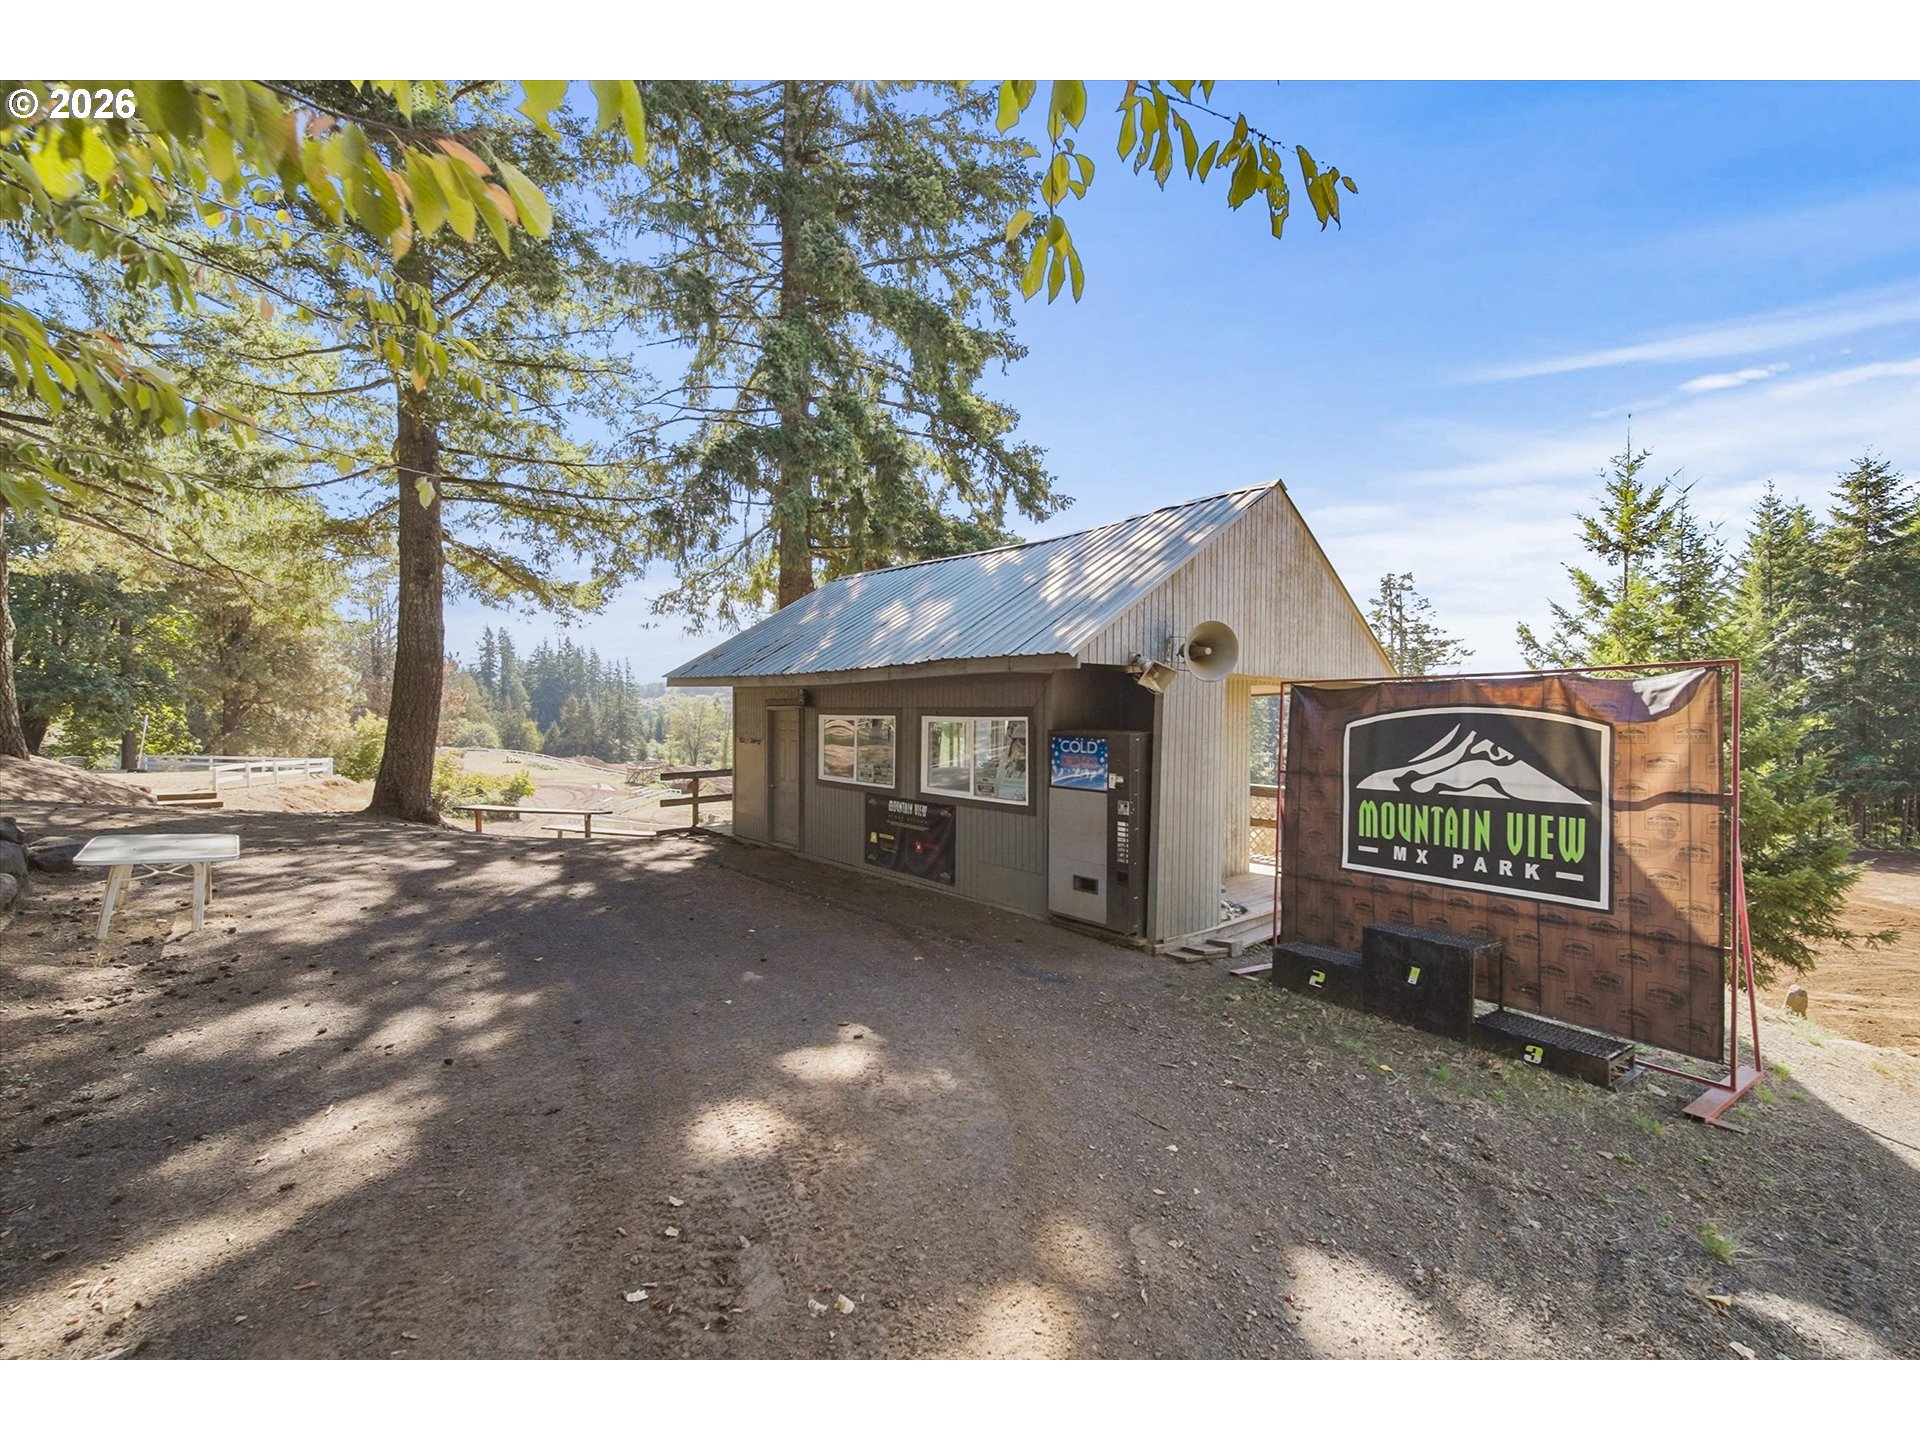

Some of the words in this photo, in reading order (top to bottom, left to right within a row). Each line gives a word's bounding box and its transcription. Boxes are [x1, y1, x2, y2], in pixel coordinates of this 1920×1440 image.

[1060, 740, 1098, 754] COLD
[1358, 799, 1491, 853] MOUNTAIN
[1506, 811, 1586, 864] VIEW
[1392, 845, 1429, 865] MX
[1452, 853, 1541, 881] PARK
[1308, 969, 1326, 988] 2
[1407, 966, 1421, 985] 1
[1523, 1044, 1544, 1064] 3
